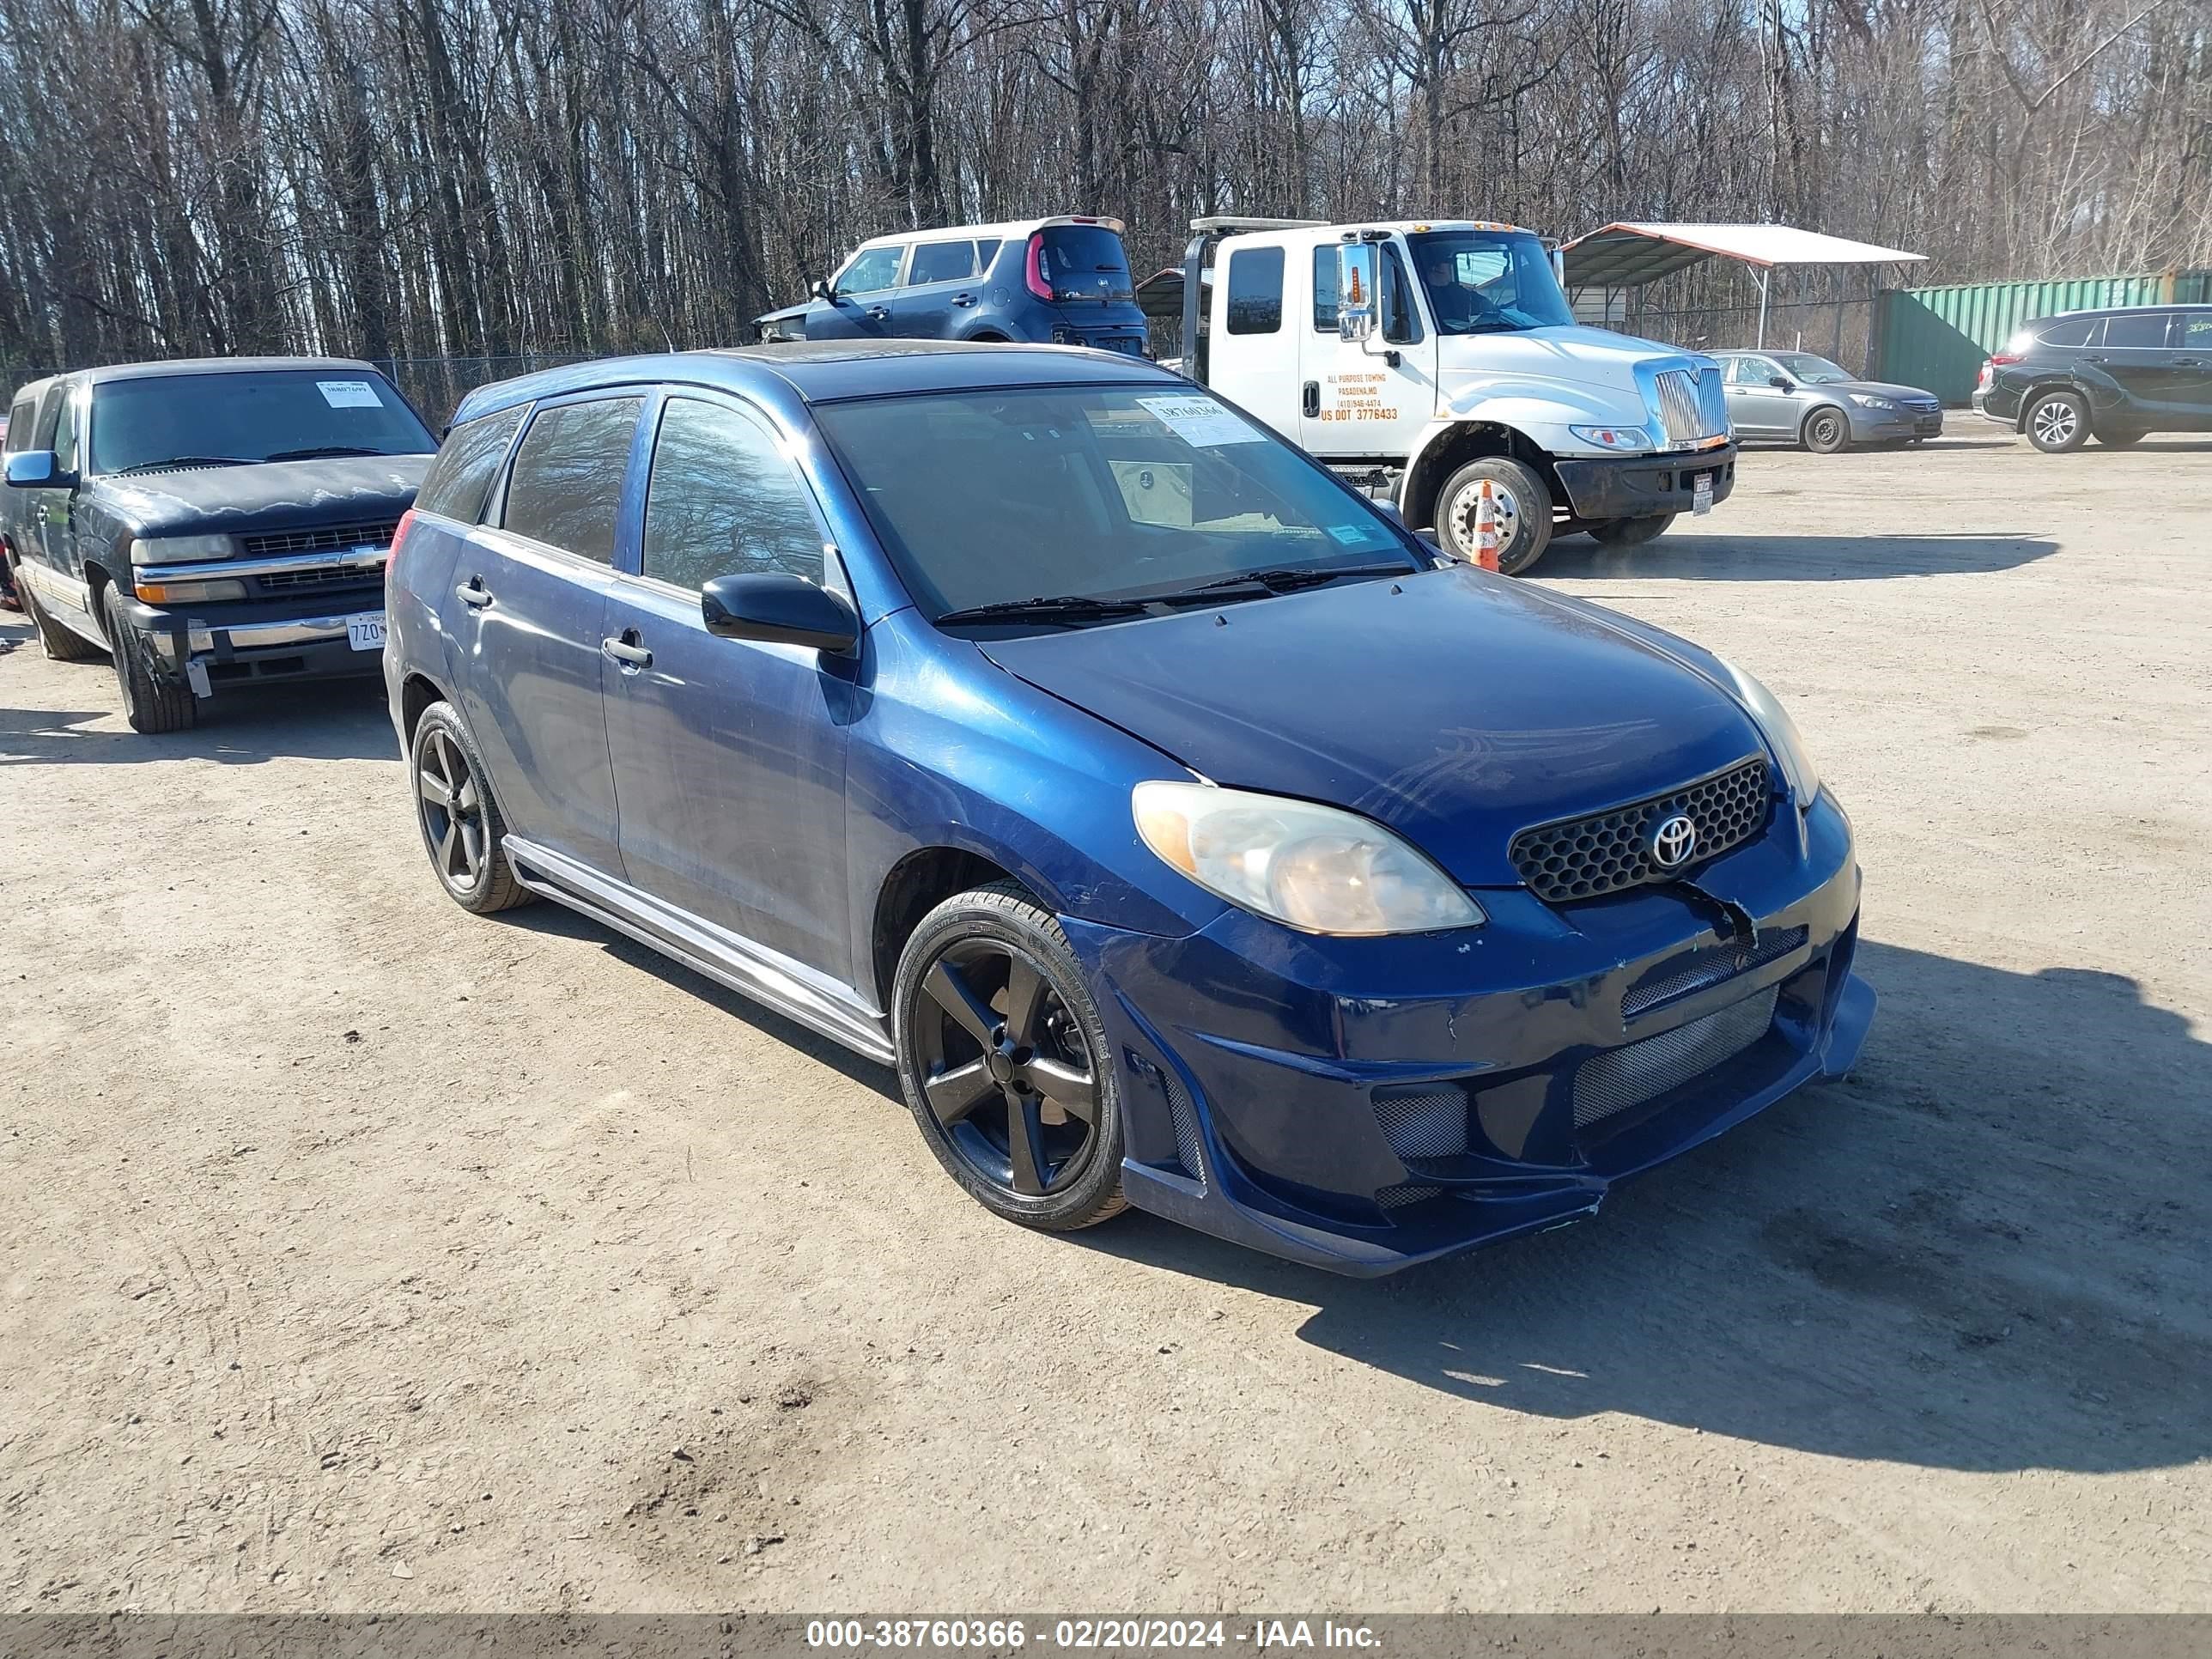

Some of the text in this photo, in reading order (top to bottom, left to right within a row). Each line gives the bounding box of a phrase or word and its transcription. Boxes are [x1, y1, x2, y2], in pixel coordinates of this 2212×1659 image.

[1328, 374, 1387, 383] ALL PURPOSE TOWING
[1158, 406, 1224, 418] 38760366
[1321, 408, 1398, 421] US DOT 3776433
